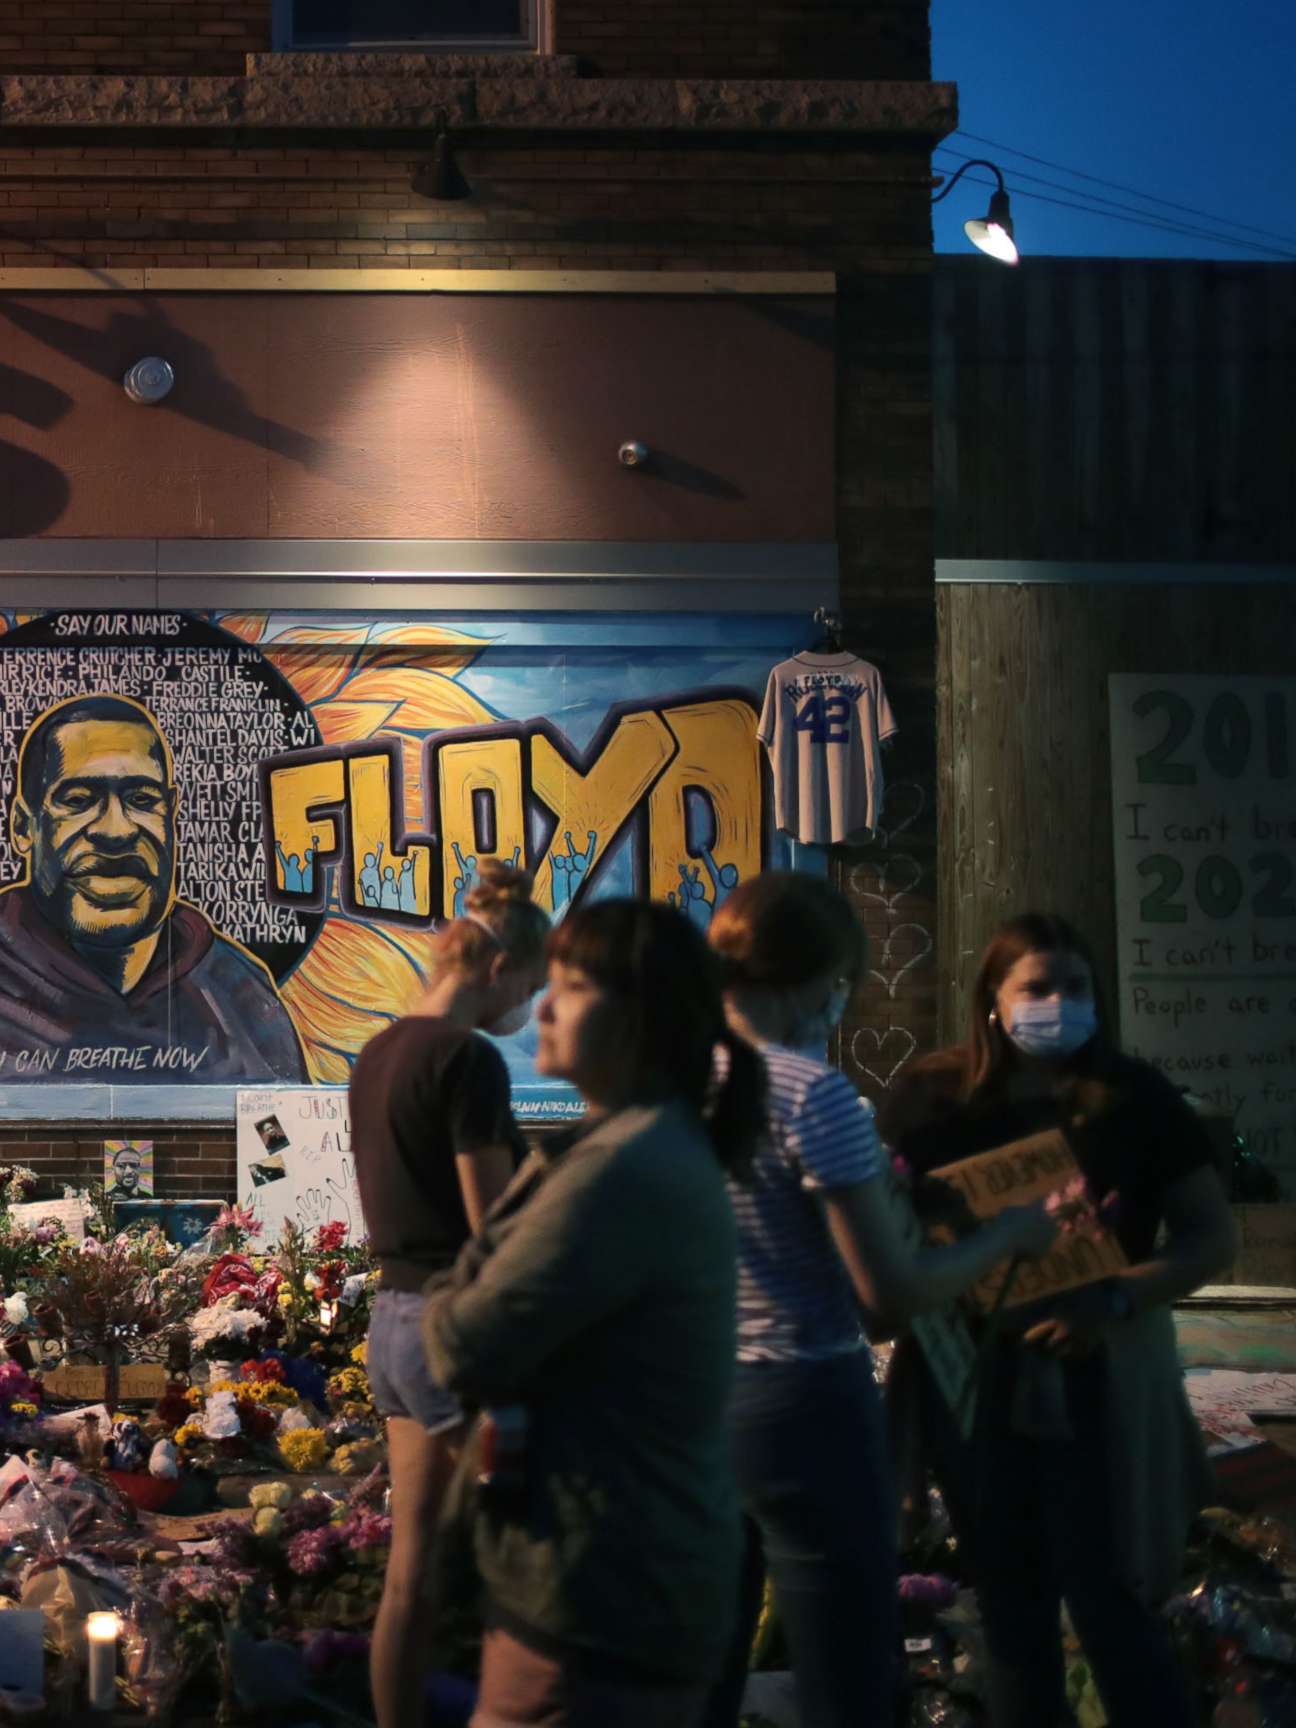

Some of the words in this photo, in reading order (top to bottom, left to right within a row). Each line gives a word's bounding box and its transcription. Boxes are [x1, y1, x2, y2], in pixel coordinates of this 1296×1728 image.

[56, 615, 91, 636] SAY
[94, 615, 129, 636] OUR
[132, 614, 181, 636] NAMES
[79, 647, 156, 666] CRUTCHER
[162, 647, 231, 667] JEREMY
[22, 664, 61, 681] RICE
[78, 666, 166, 680] PHILANDO
[182, 665, 245, 682] CASTILE
[29, 679, 86, 697] KENDRA
[89, 679, 141, 698] JAMES
[153, 681, 217, 698] FREDDIE
[222, 681, 263, 699] GREY
[145, 697, 208, 713] TERRANCE
[211, 698, 281, 713] FRANKLIN
[156, 712, 225, 730] BREONNA
[228, 713, 286, 730] TAYLOR
[295, 712, 314, 729] AL
[793, 696, 850, 743] 42
[166, 729, 236, 747] SHANTEL
[239, 729, 284, 747] DAVIS
[169, 747, 234, 764] WALTER
[173, 764, 216, 782] REKIA
[178, 800, 237, 821] SHELLY
[270, 699, 762, 922] FLOYD
[176, 821, 234, 843] JAMAR
[1125, 803, 1150, 840] I
[1164, 814, 1231, 843] can't
[177, 843, 247, 863] TANISHA
[177, 862, 238, 881] TARIKA
[178, 881, 232, 901] ALTON
[234, 881, 264, 902] STE
[222, 924, 306, 944] KATHRYN
[1133, 939, 1152, 967] I
[1166, 940, 1237, 967] can't
[1133, 987, 1207, 1029] People
[1227, 996, 1271, 1016] are
[15, 1049, 58, 1072] CAN
[63, 1046, 152, 1071] BREATHE
[153, 1047, 209, 1072] NOW
